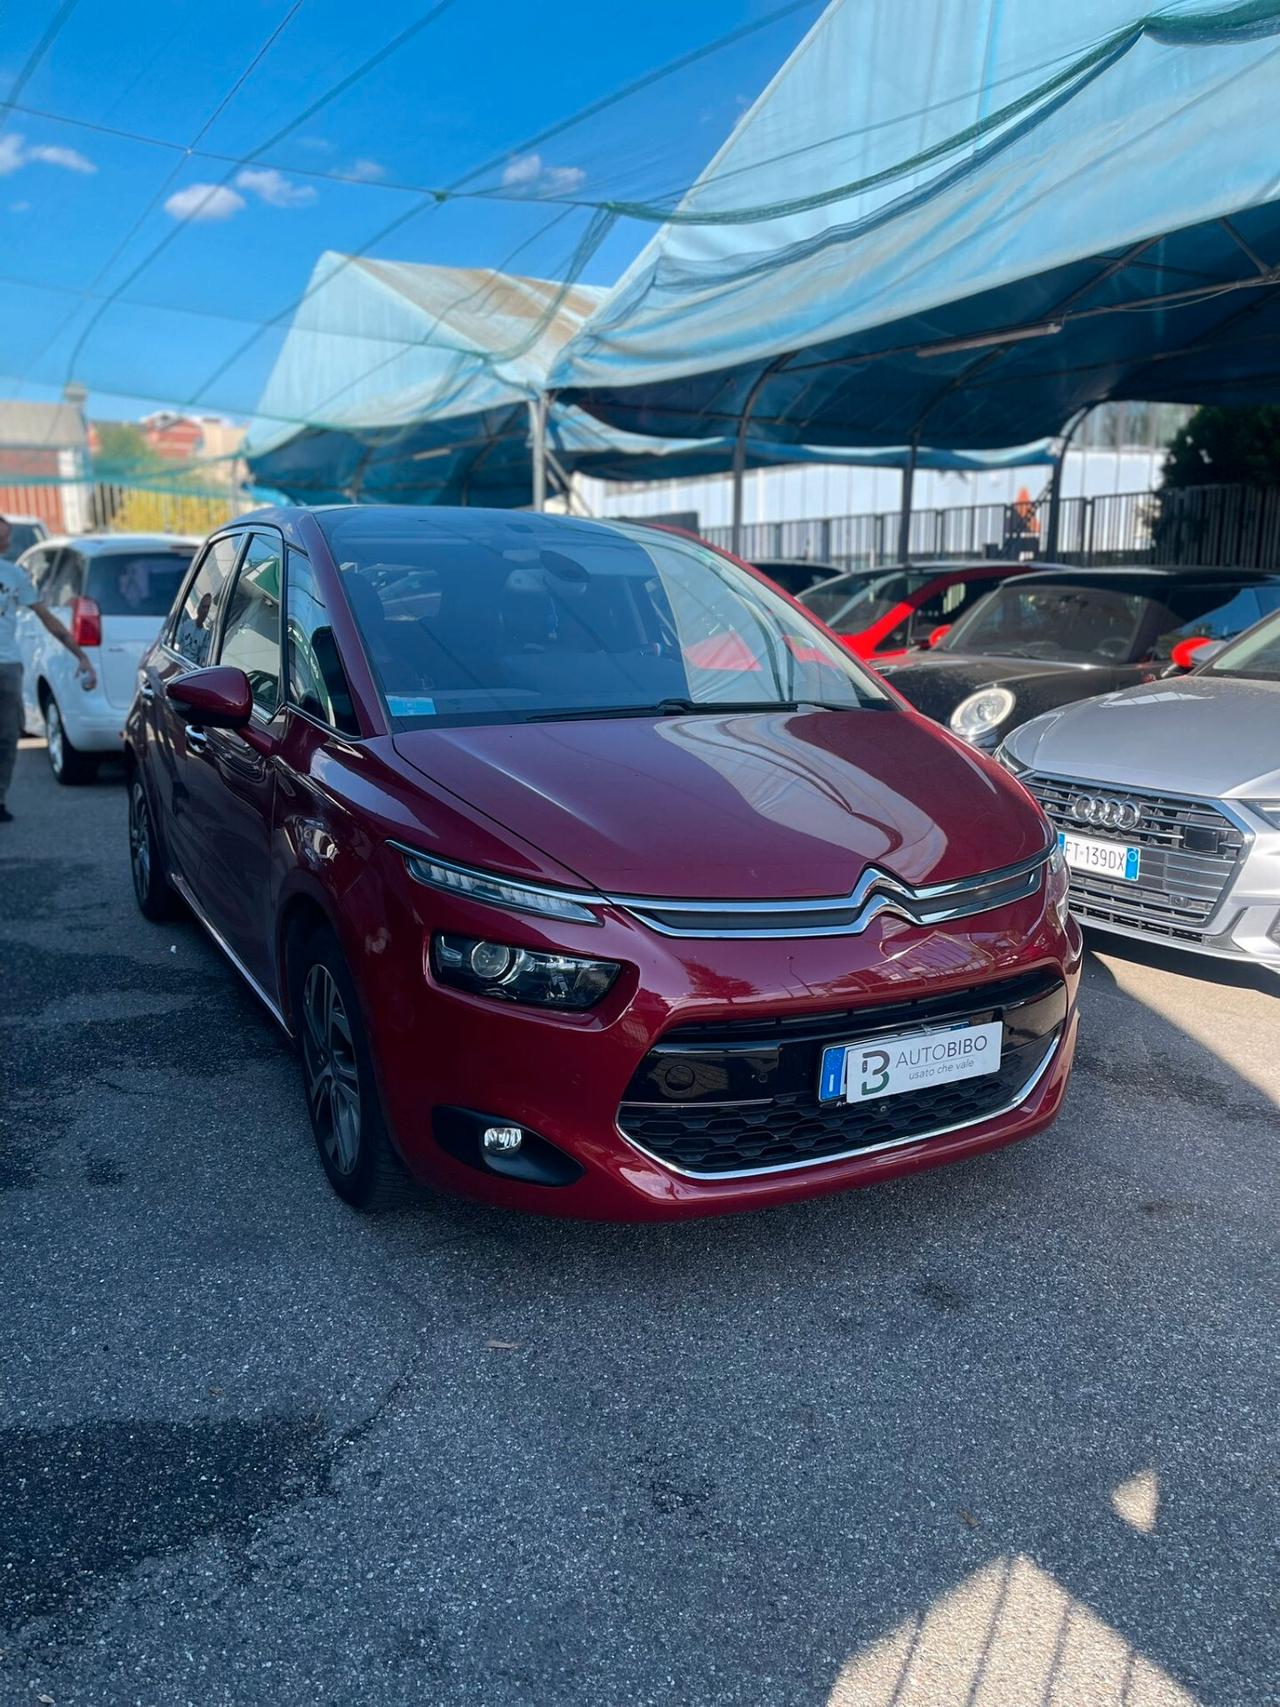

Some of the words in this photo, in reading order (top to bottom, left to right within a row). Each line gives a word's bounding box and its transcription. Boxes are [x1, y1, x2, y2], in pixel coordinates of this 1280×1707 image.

[895, 1035, 988, 1069] AUTOBIBO
[908, 1068, 935, 1080] usato
[937, 1062, 954, 1077] che
[955, 1058, 975, 1071] vale
